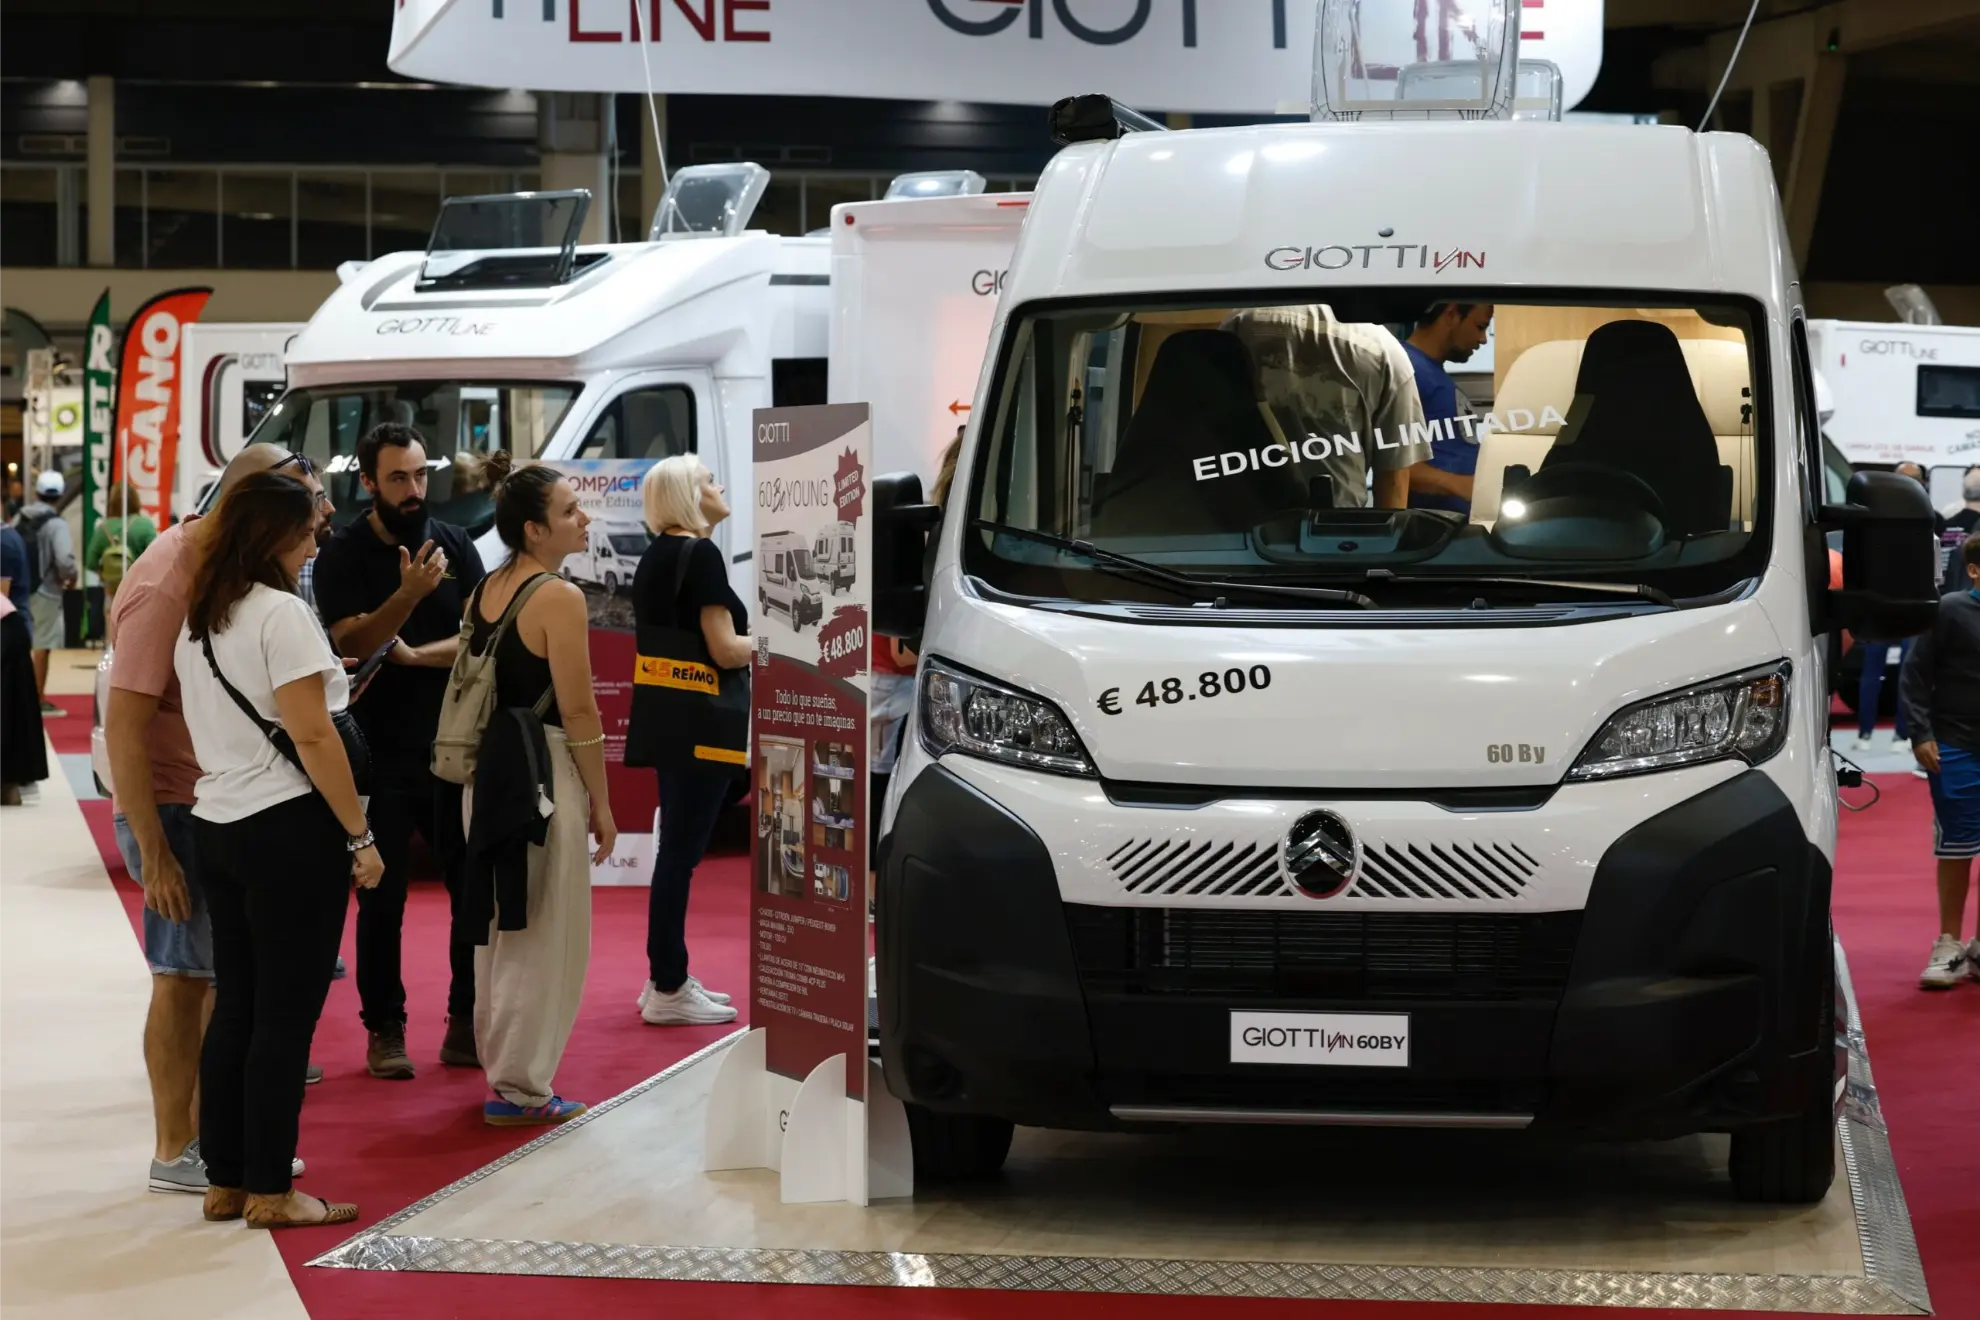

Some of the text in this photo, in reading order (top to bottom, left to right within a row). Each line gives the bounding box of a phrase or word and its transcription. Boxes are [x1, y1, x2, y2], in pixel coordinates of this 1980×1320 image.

[1374, 405, 1568, 450] LIMITADA
[838, 471, 859, 492] LIMITED
[839, 486, 860, 508] EDITION
[823, 626, 864, 662] € 48.800
[775, 689, 838, 712] Todo lo que sueñas,
[1096, 664, 1272, 716] € 48.800
[758, 708, 856, 732] a un precio que no te imaginas.
[1486, 743, 1545, 764] 60 By
[1356, 1035, 1406, 1050] 60BY
